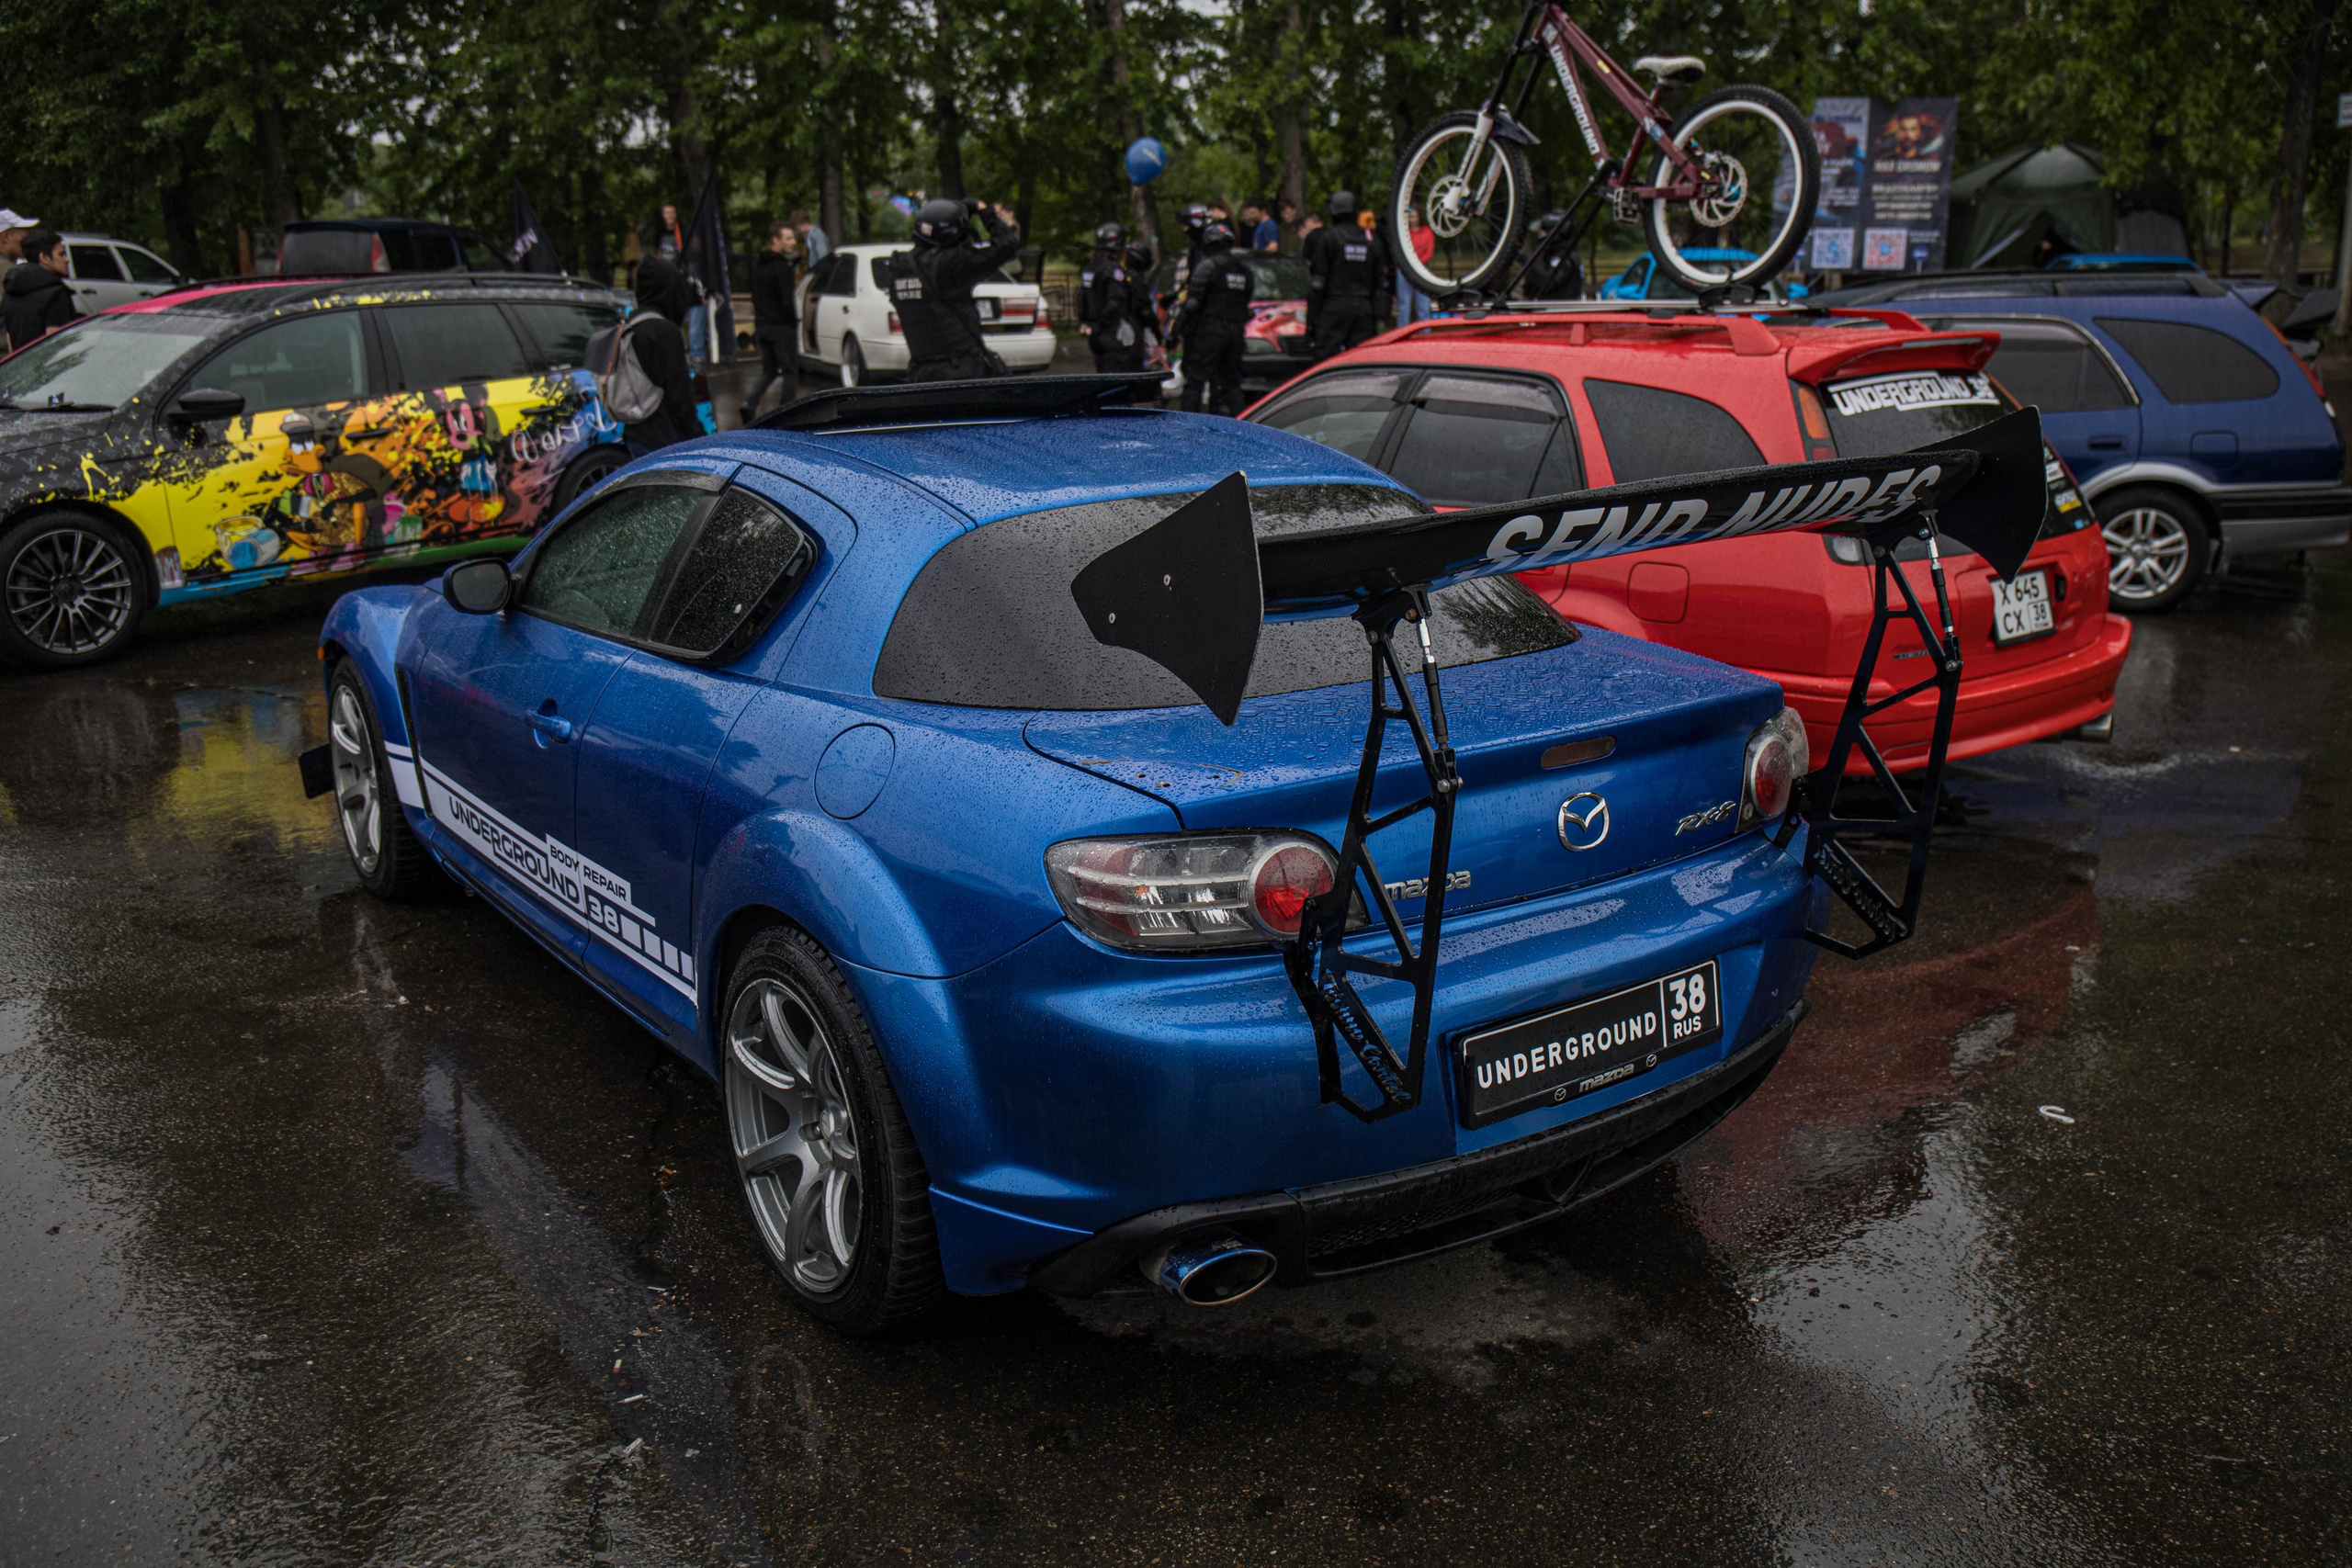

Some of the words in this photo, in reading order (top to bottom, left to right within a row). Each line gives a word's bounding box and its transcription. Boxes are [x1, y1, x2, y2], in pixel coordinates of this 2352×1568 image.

[1549, 44, 1600, 155] UNDERGROUND
[1830, 371, 1973, 416] UNDERGROUND
[1711, 465, 1942, 538] NUDES
[2015, 576, 2040, 602] 645
[2032, 604, 2047, 621] 38
[1675, 800, 1736, 837] RX-8
[448, 795, 581, 905] UNDERGROUND
[587, 895, 620, 934] 38
[549, 843, 581, 873] BODY
[582, 864, 628, 902] REPAIR
[1668, 973, 1707, 1021] 38
[1476, 1011, 1657, 1089] UNDERGROUND
[1673, 1015, 1702, 1040] RUS
